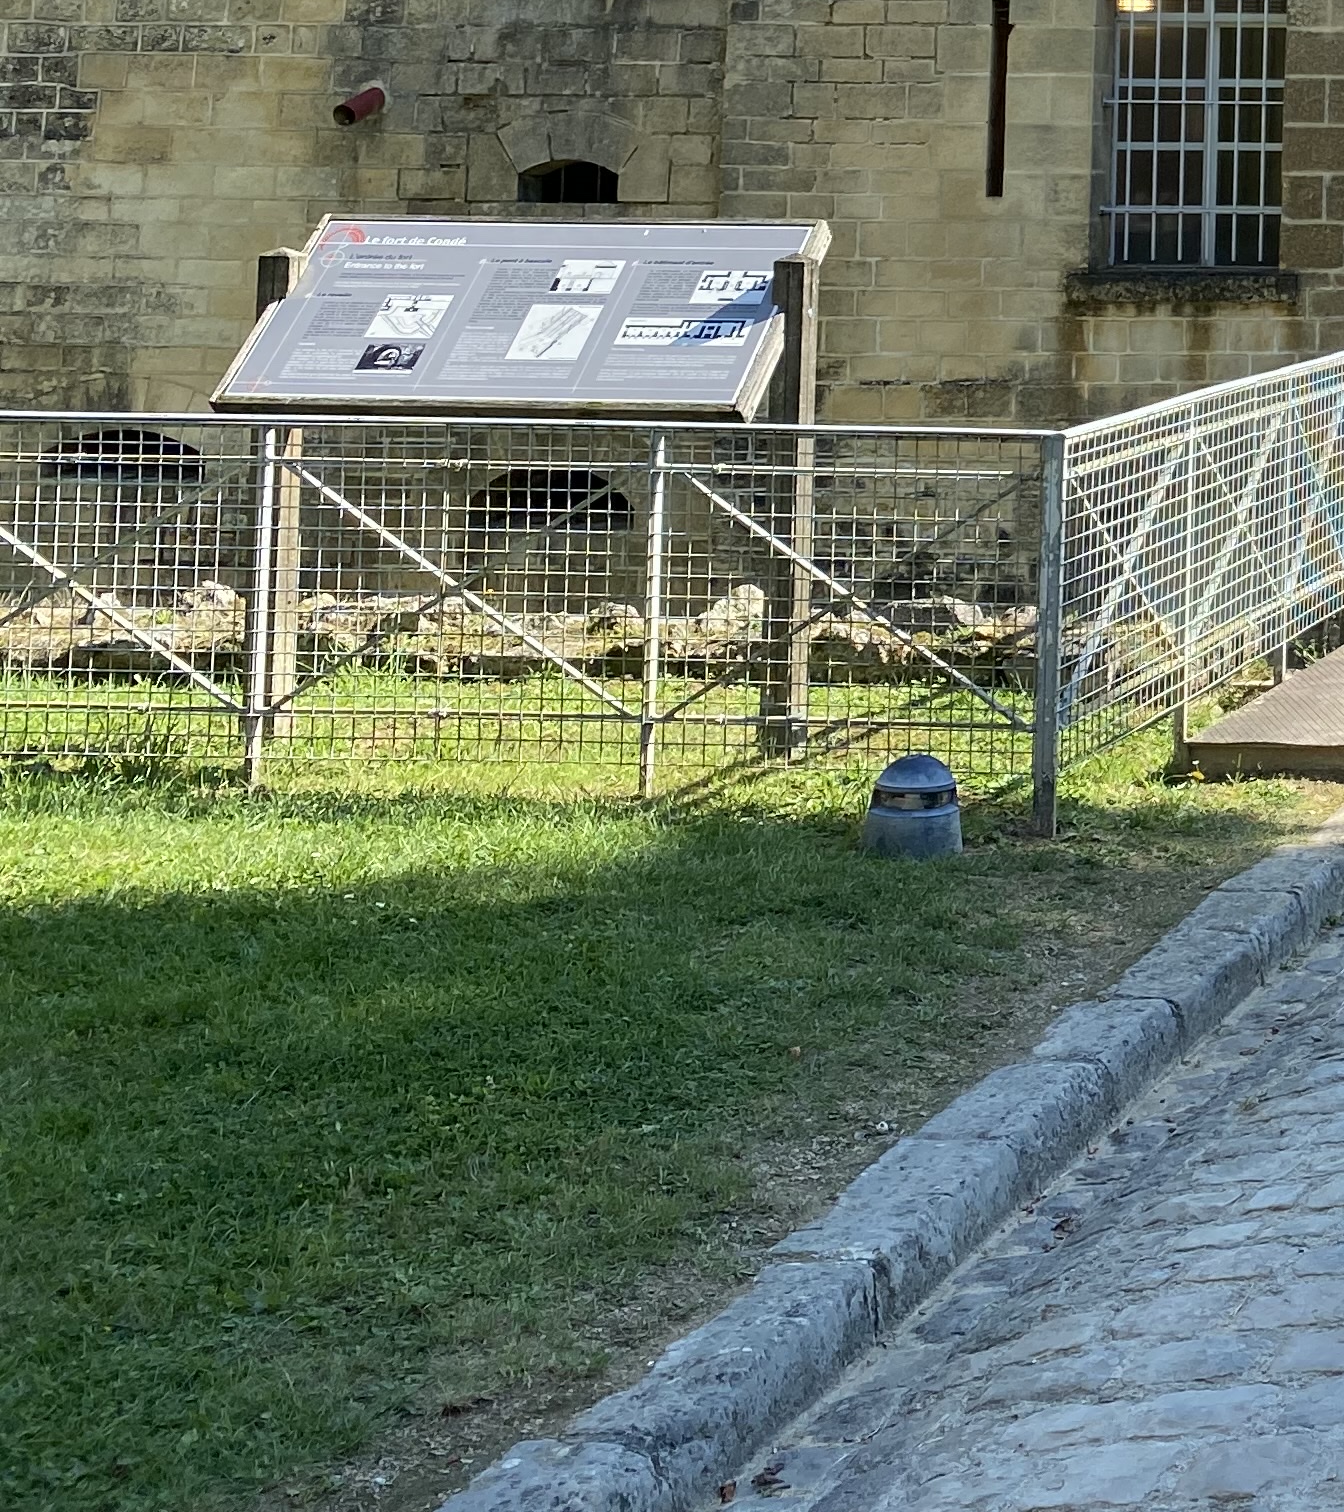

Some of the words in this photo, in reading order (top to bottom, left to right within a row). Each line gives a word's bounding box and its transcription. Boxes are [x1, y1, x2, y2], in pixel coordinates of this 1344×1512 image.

[364, 236, 381, 245] Le
[381, 236, 407, 245] fort
[408, 236, 426, 245] de
